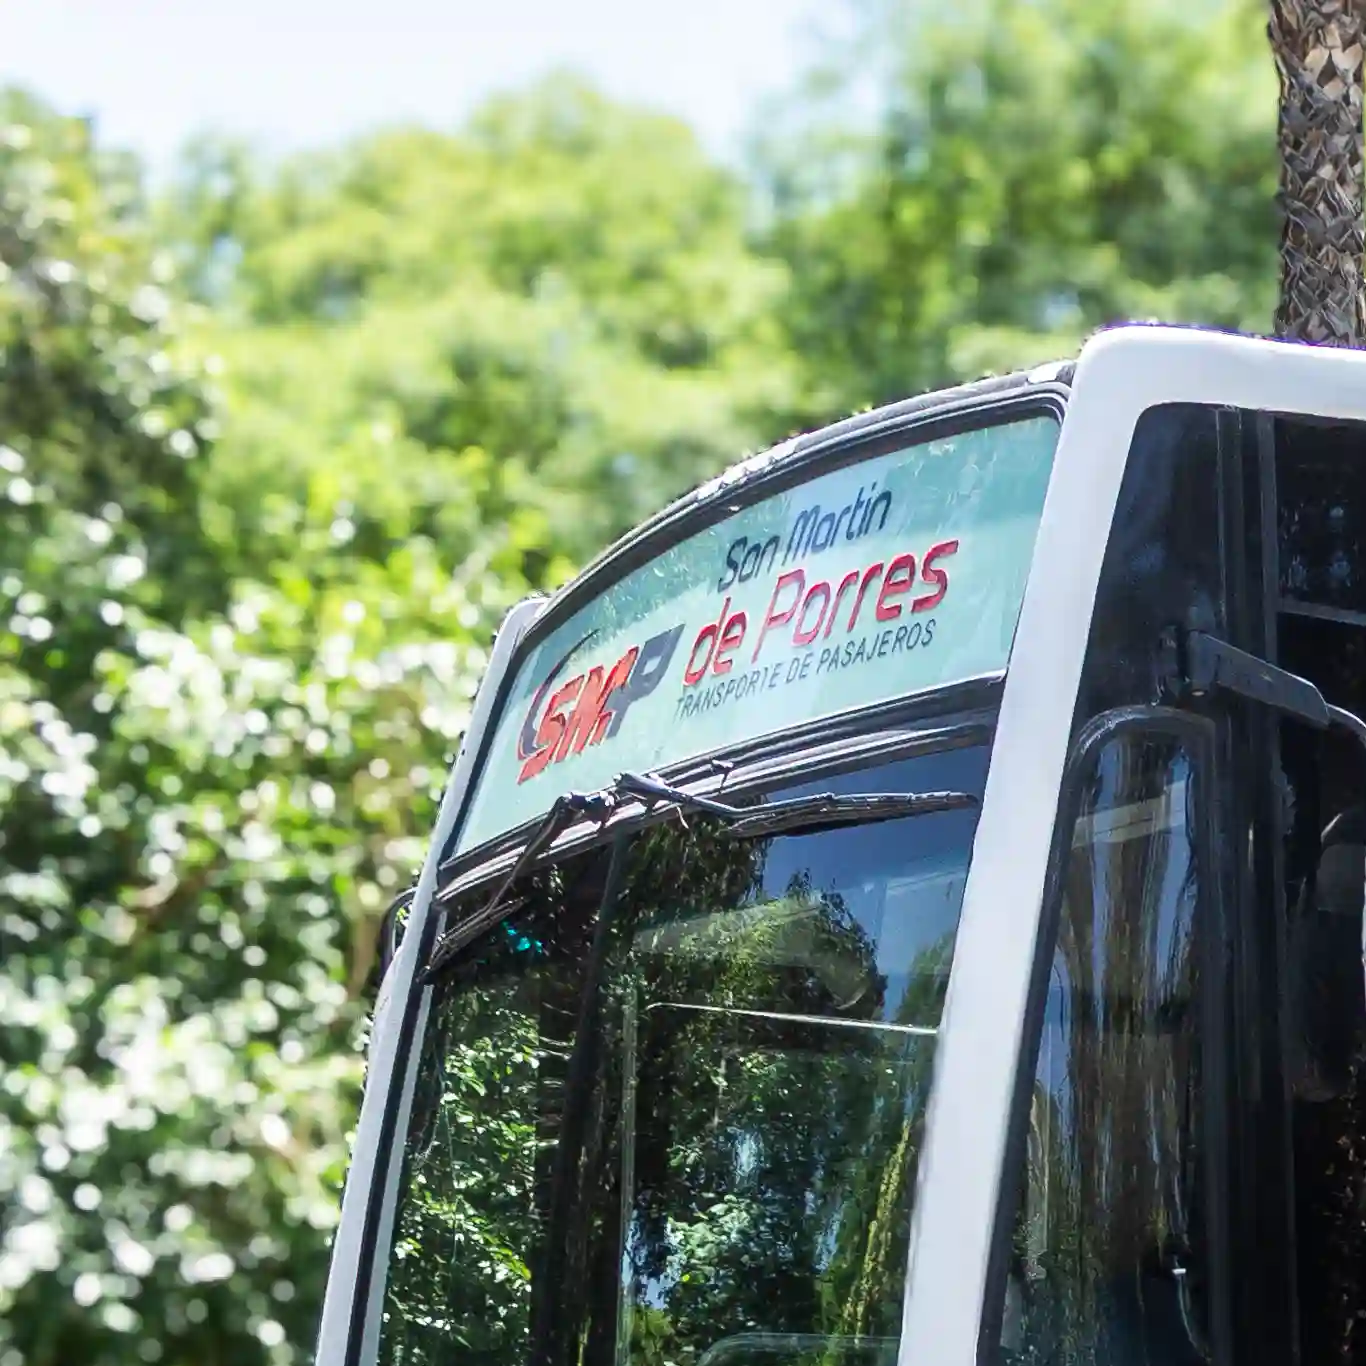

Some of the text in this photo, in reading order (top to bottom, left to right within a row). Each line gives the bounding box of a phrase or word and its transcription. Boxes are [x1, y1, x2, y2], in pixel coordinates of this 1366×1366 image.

[717, 483, 892, 592] San Martin
[674, 619, 938, 727] TRANSPORTE DE PASAJEROS
[682, 540, 959, 689] de Porres
[517, 623, 686, 785] SMP
